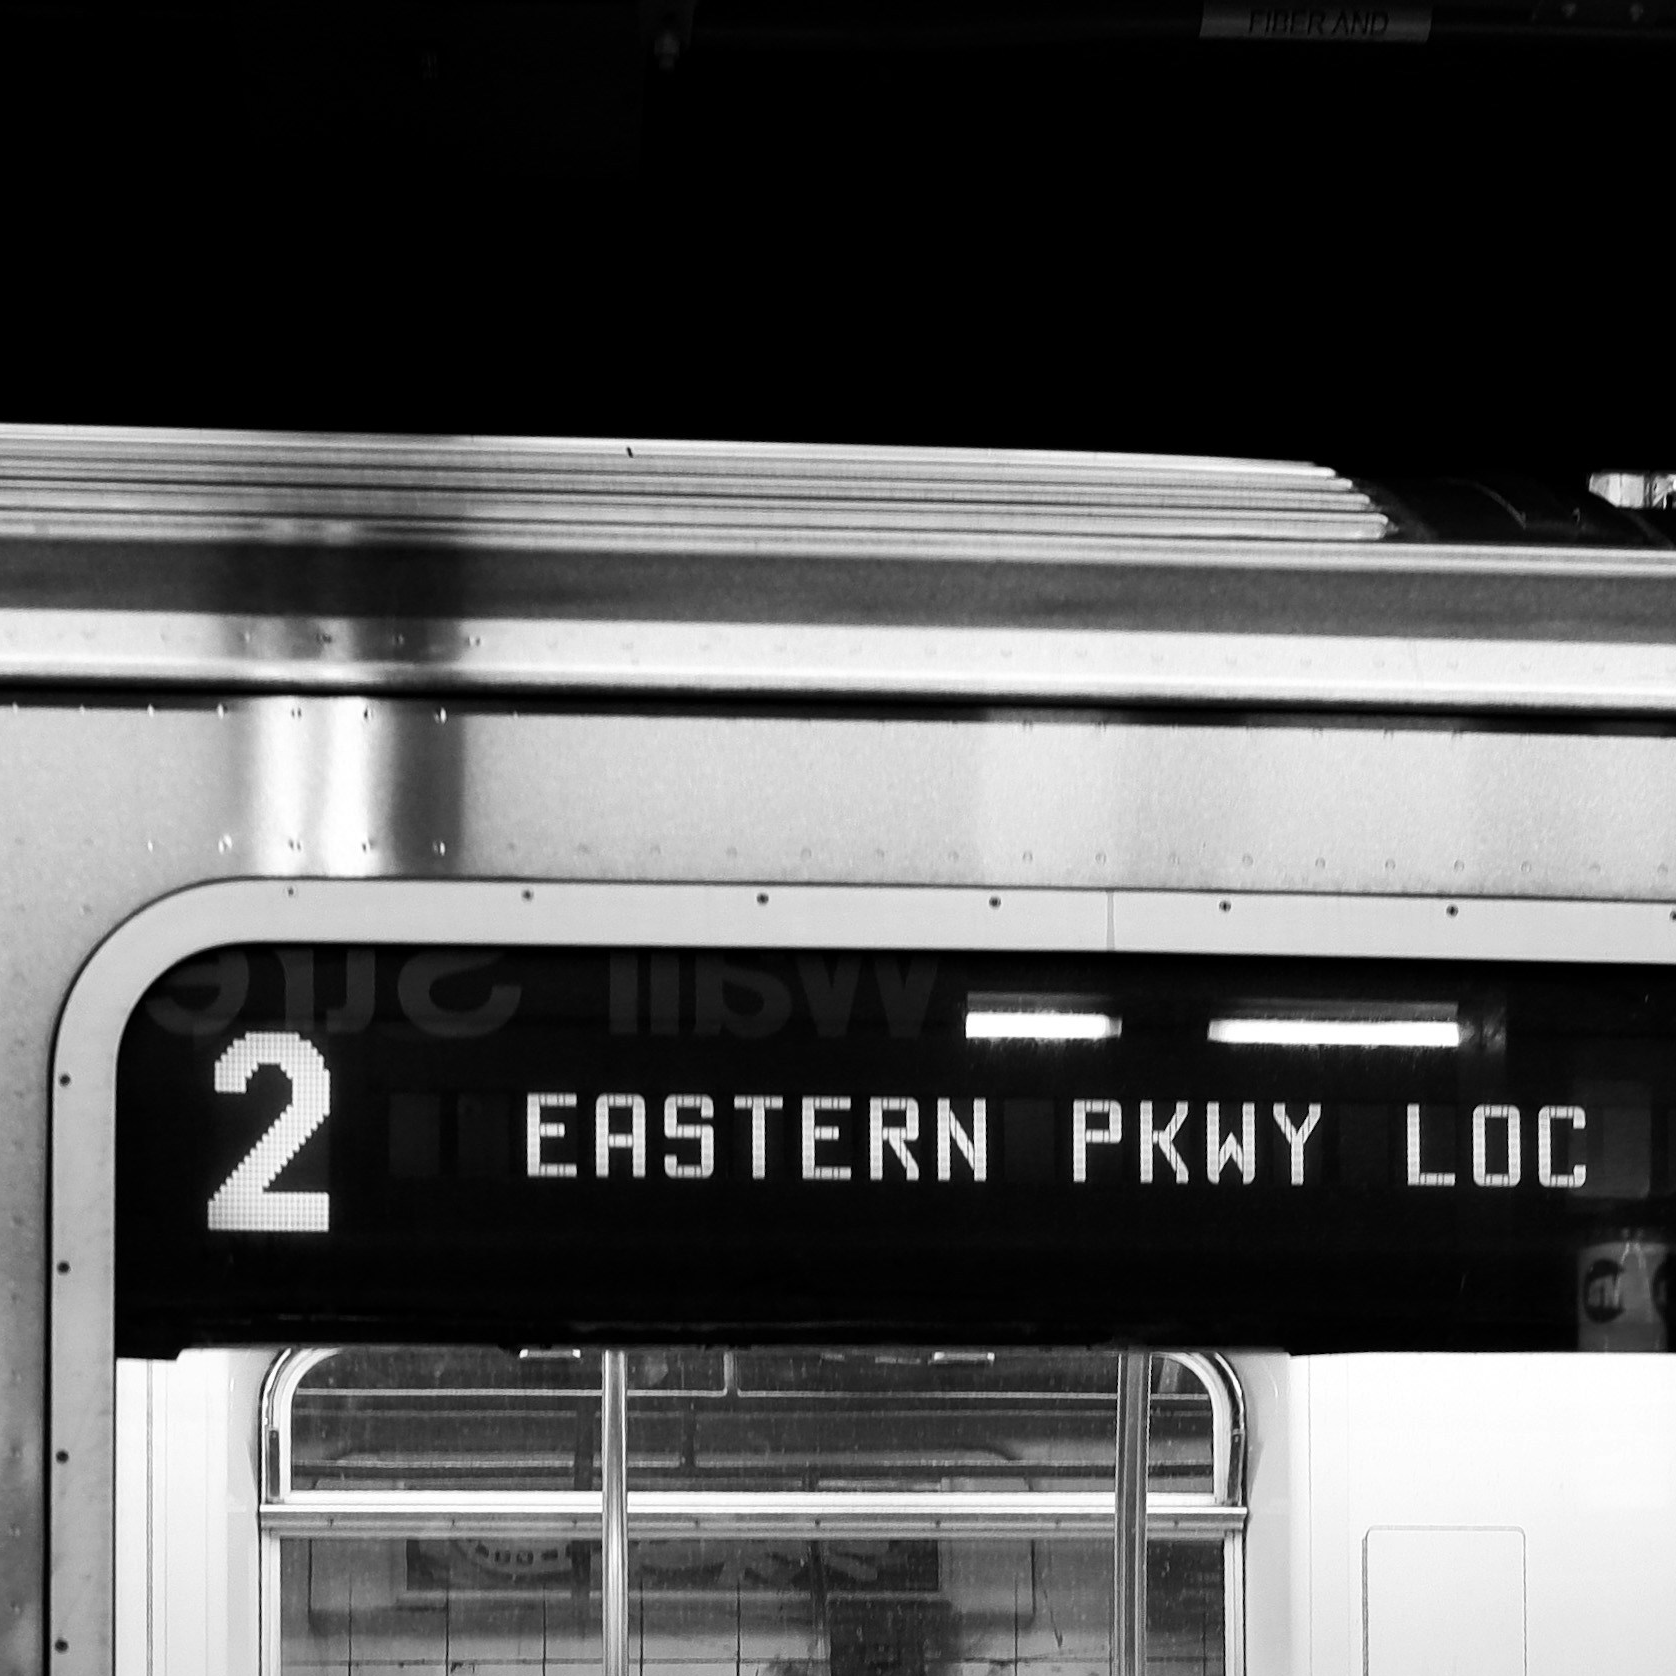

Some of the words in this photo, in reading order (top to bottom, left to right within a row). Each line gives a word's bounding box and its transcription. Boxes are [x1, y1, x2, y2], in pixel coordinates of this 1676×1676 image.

[1331, 8, 1390, 36] AND
[207, 1031, 331, 1232] 2
[526, 1092, 987, 1182] EASTERN
[1072, 1100, 1322, 1185] PKWY
[1406, 1104, 1588, 1188] LOC
